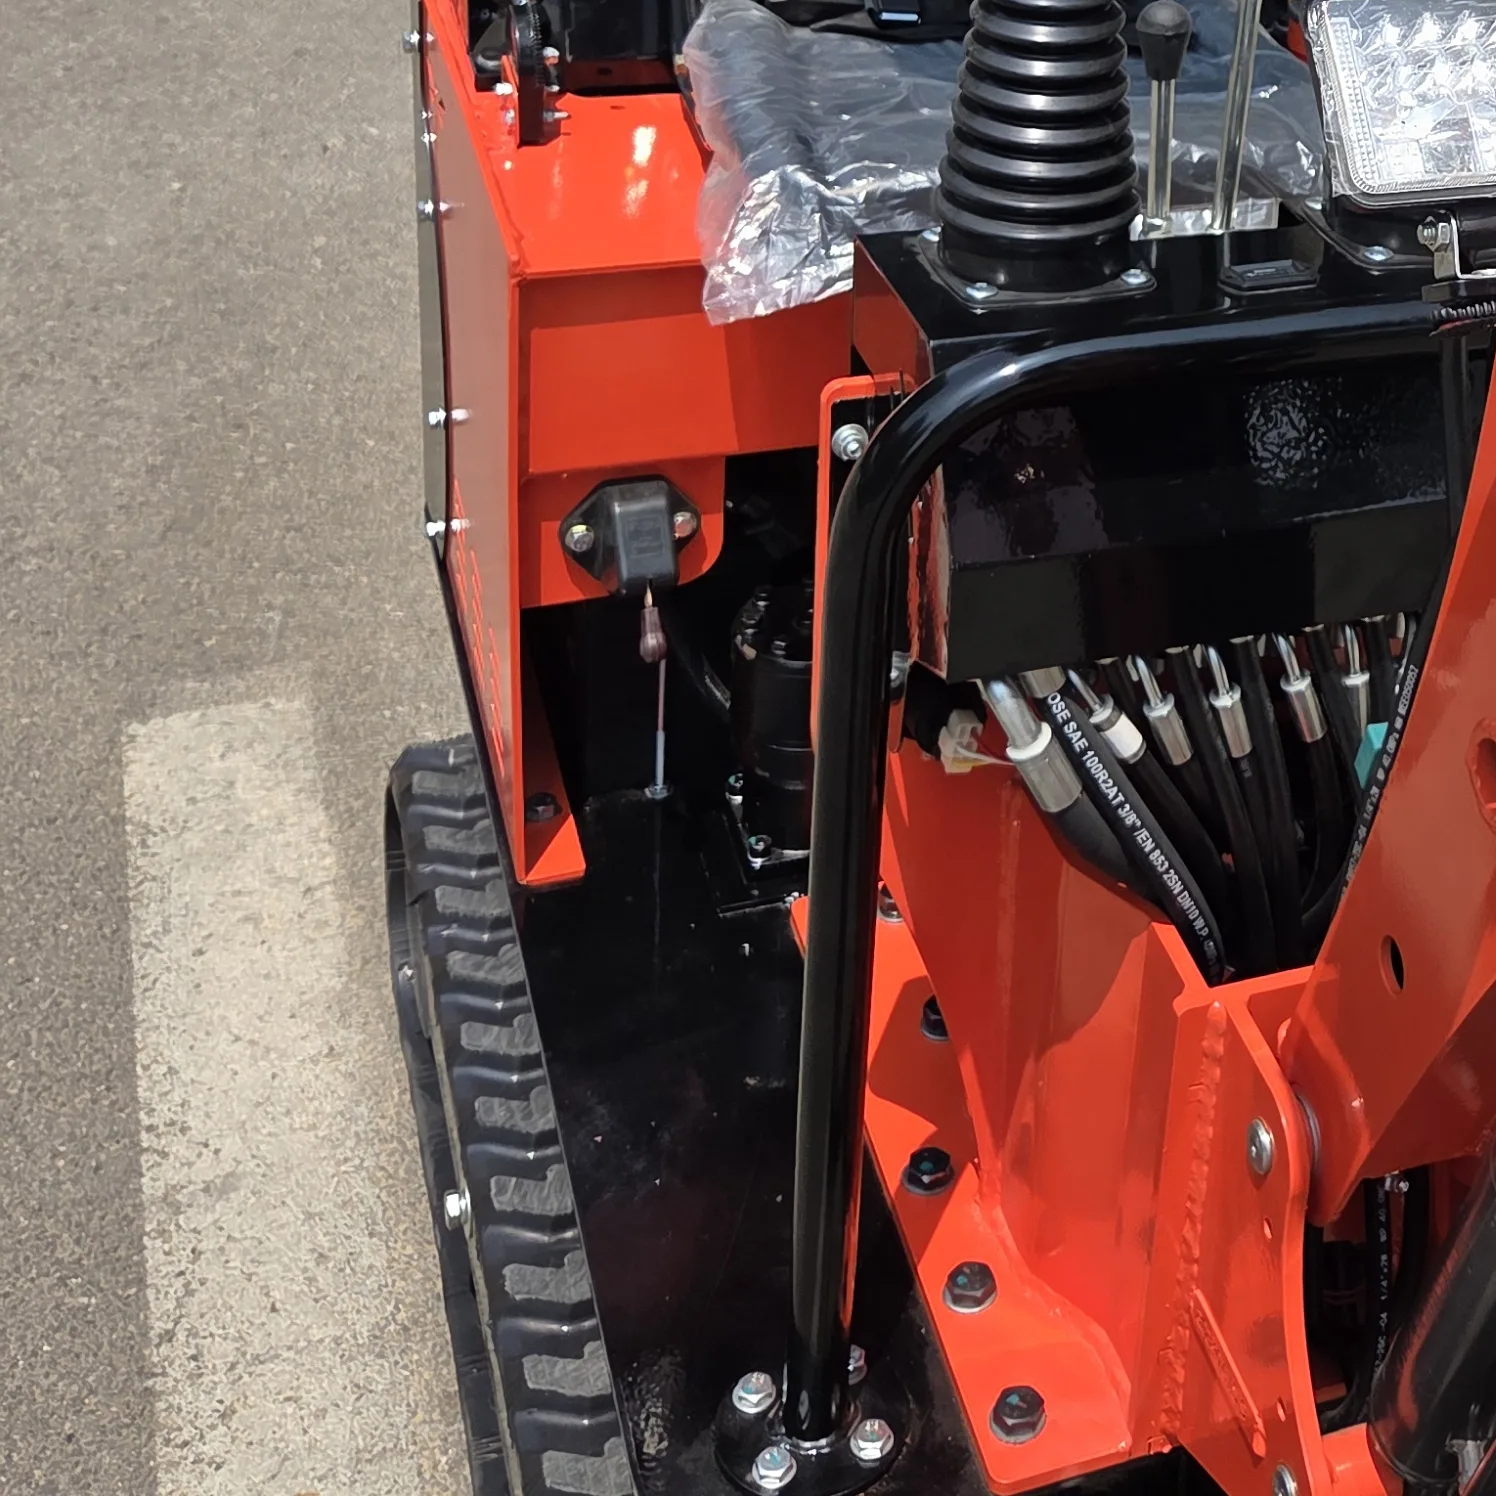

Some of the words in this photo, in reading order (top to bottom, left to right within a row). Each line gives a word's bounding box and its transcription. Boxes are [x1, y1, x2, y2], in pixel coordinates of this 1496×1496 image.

[1063, 721, 1089, 753] SAE
[1081, 750, 1125, 807] 100R2AT
[1133, 826, 1156, 854] /EN
[1149, 848, 1170, 873] 853
[1161, 868, 1184, 895] 2SN
[1176, 890, 1201, 922] DN10
